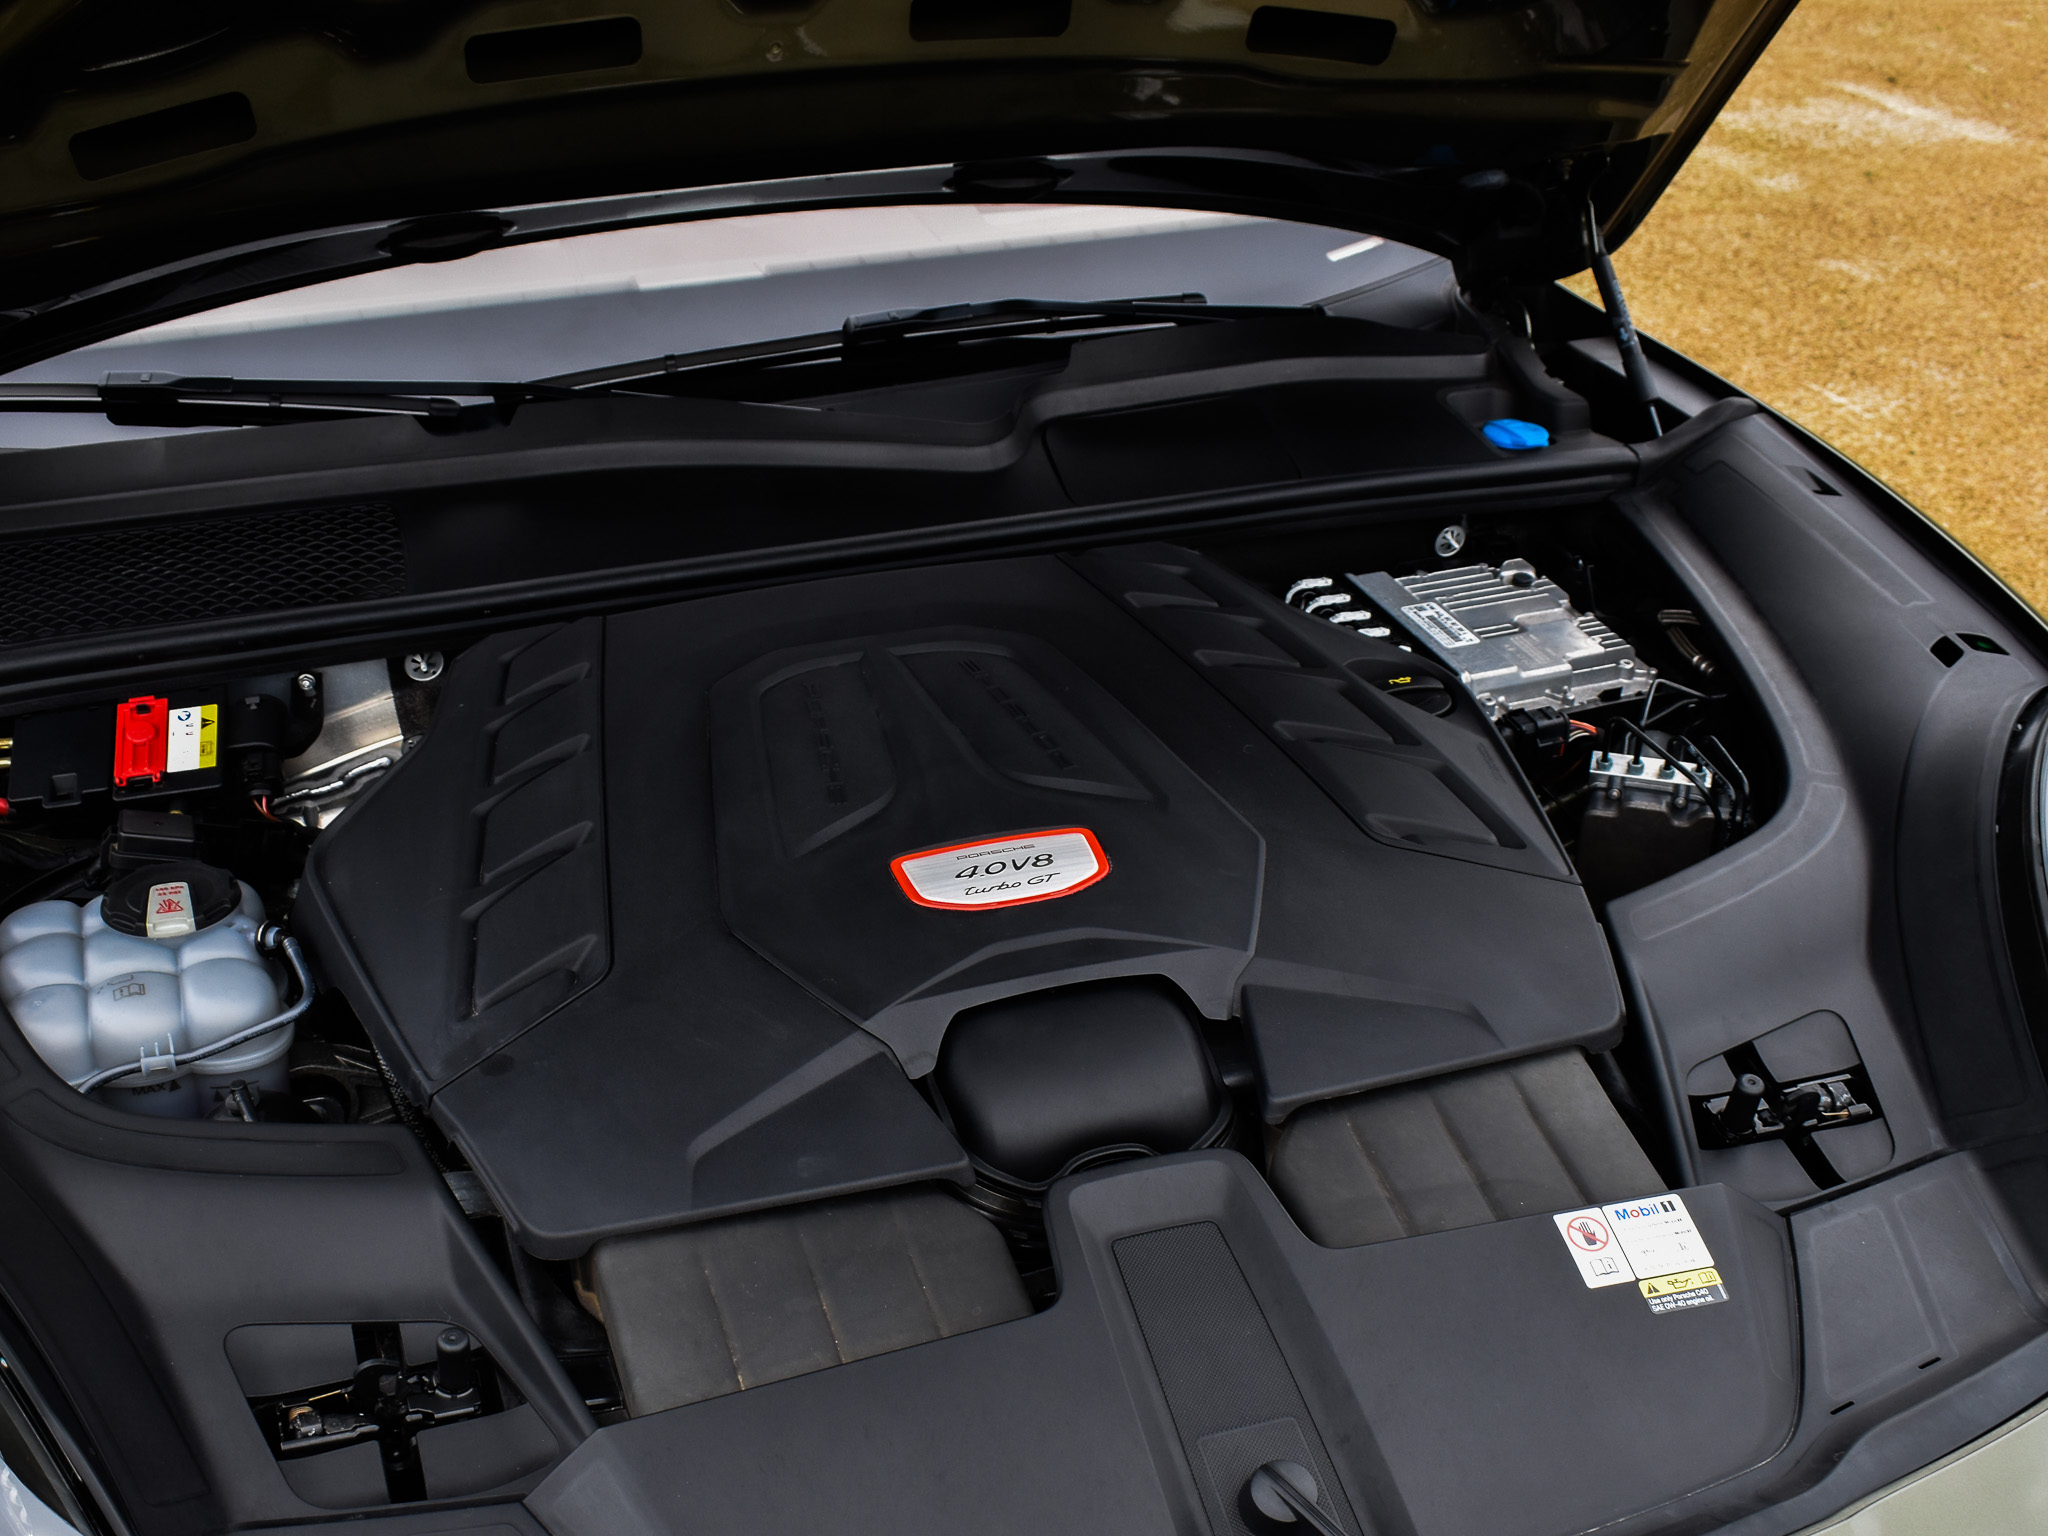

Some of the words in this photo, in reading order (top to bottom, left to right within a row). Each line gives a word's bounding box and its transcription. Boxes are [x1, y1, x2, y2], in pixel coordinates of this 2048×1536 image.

[955, 843, 1036, 861] PORSCHE
[1027, 872, 1061, 885] GT
[131, 1082, 166, 1096] MAX
[1614, 1203, 1660, 1221] Mobil
[1648, 1297, 1662, 1305] Use
[1661, 1295, 1674, 1304] only
[1672, 1291, 1697, 1301] Porsche
[1695, 1287, 1710, 1296] C40
[1651, 1303, 1666, 1312] SAE
[1664, 1299, 1687, 1309] 0W-40
[1685, 1296, 1706, 1306] engine
